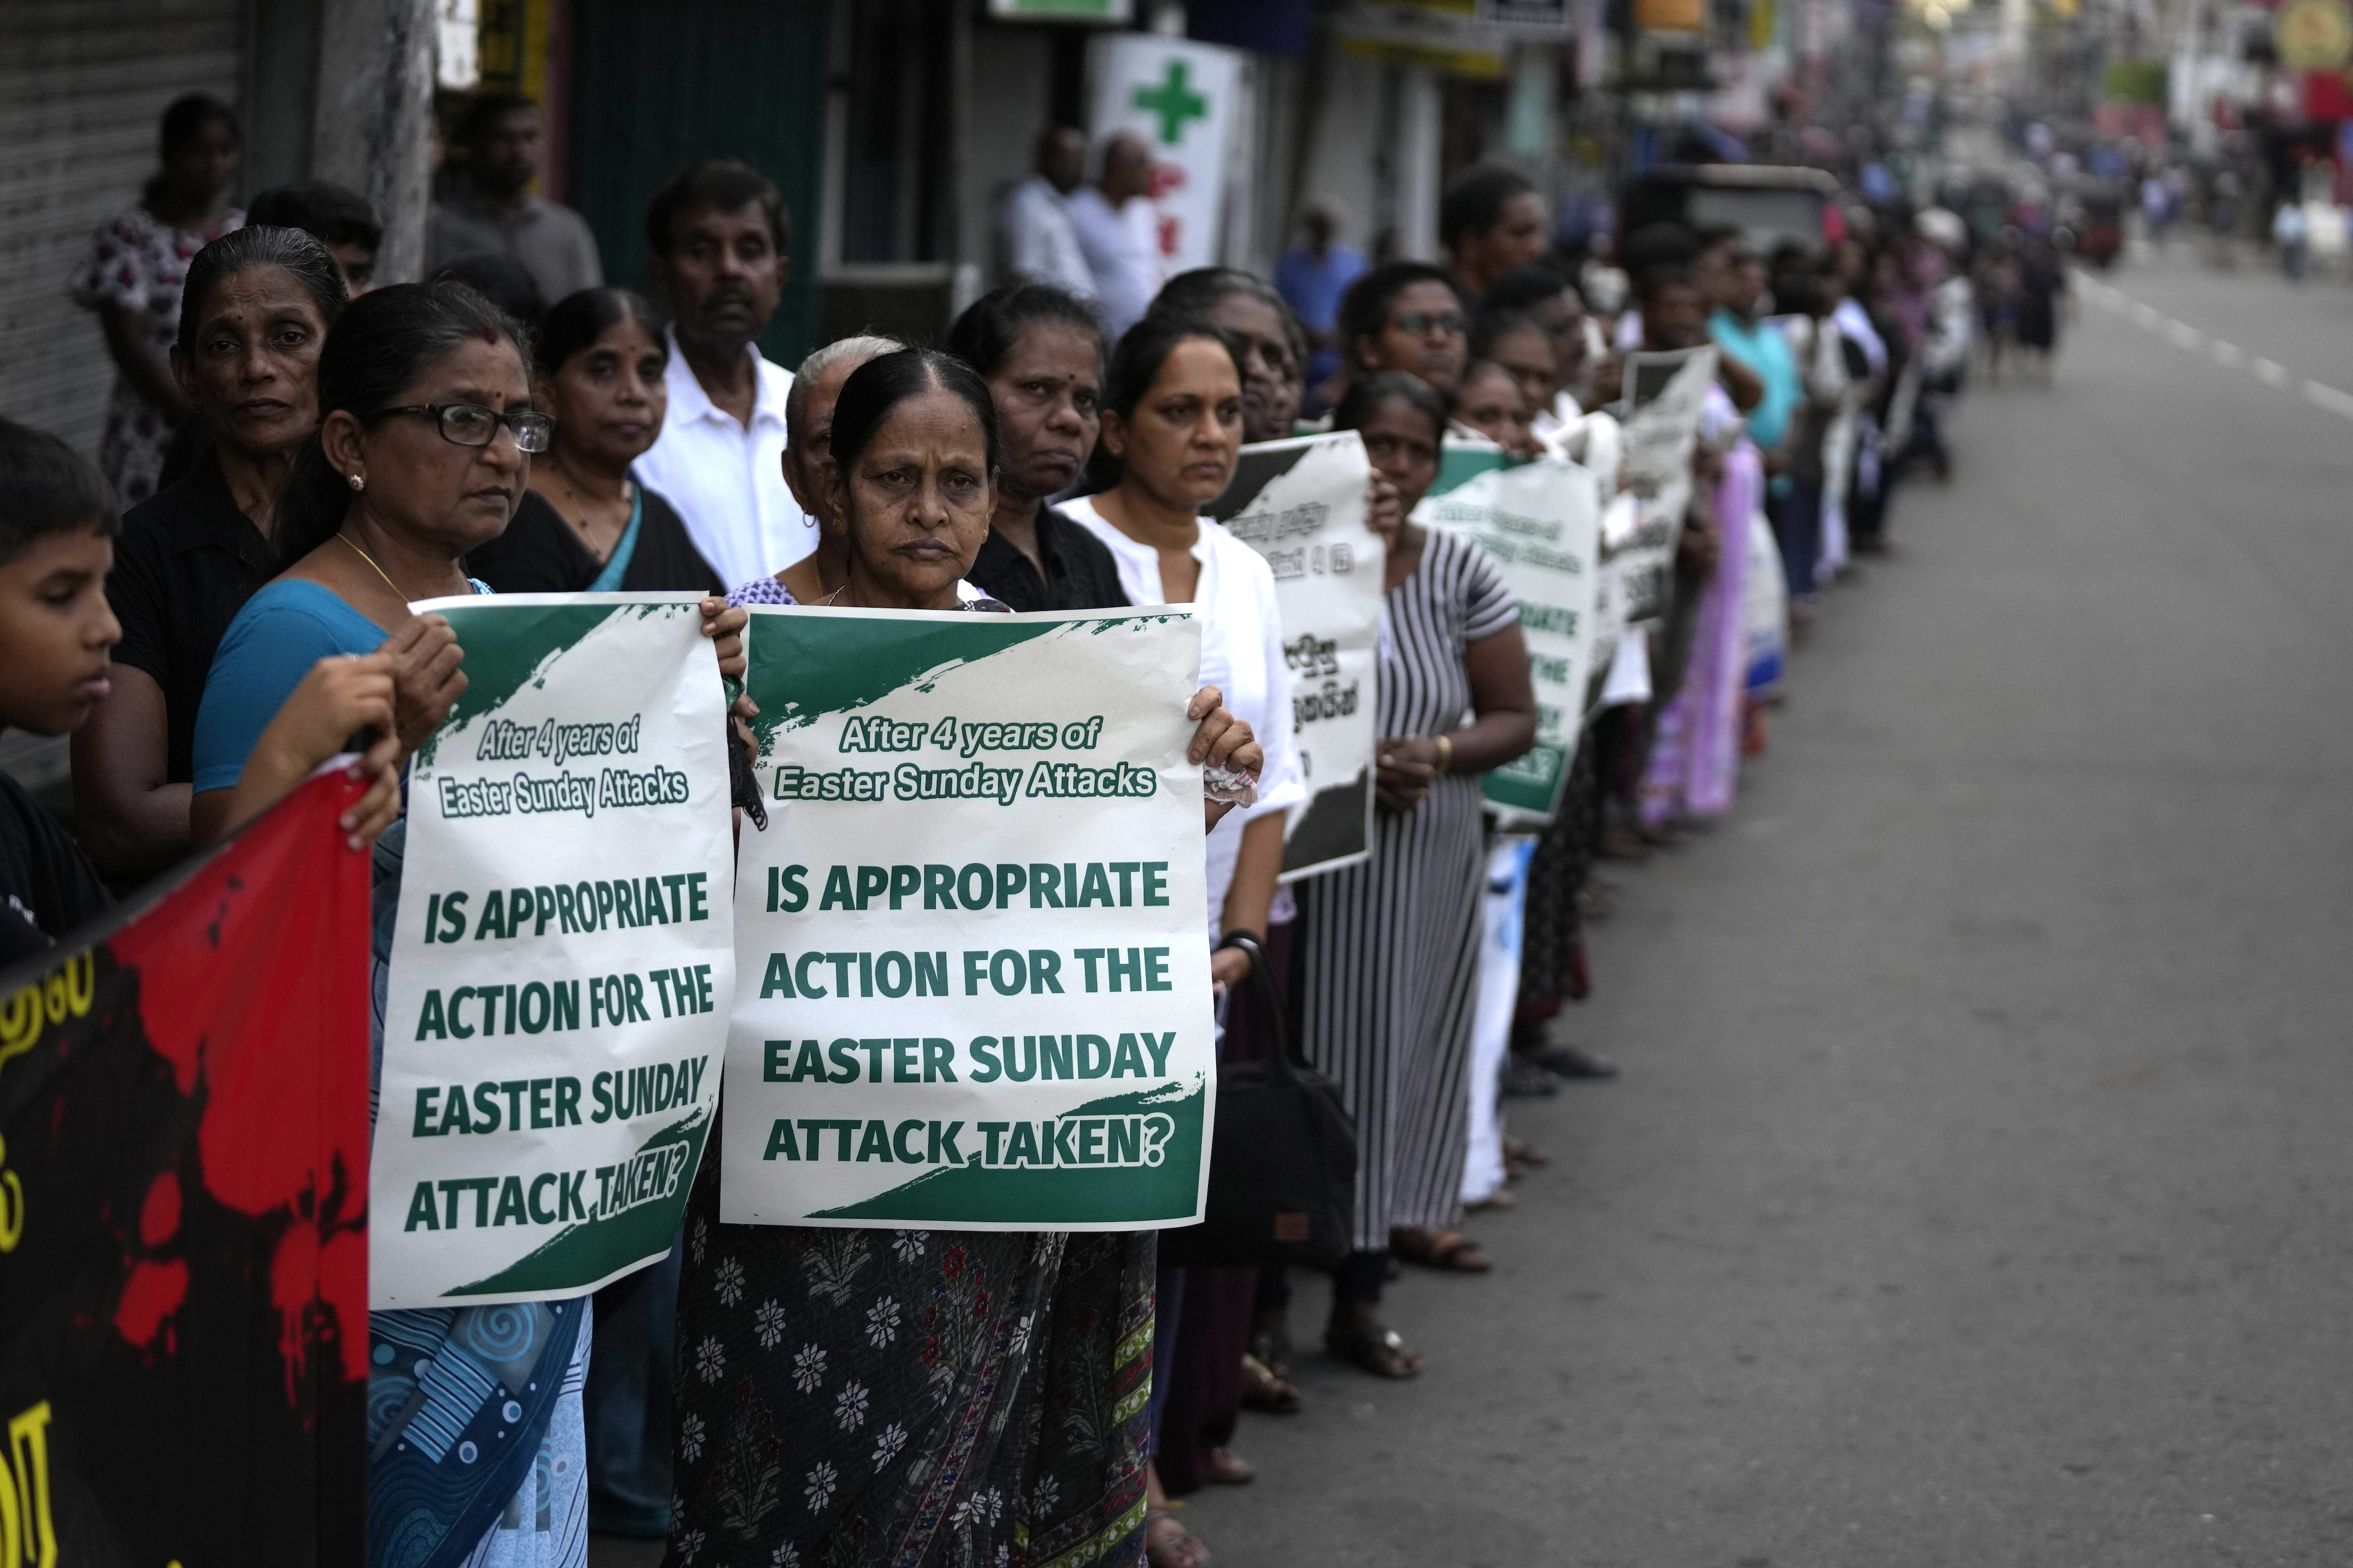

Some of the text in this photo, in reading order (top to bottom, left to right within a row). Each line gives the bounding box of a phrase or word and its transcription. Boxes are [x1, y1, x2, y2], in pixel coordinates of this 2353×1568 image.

[477, 713, 641, 766] After 4 years of
[839, 714, 1103, 758] After 4 years of
[438, 765, 690, 818] Easter Sunday Attacks
[774, 760, 1157, 806] Easter Sunday Attacks
[424, 871, 709, 944] IS APPROPRIATE
[766, 861, 1170, 913] IS APPROPRIATE
[760, 946, 1173, 999] ACTION FOR THE
[414, 963, 715, 1042] ACTION FOR THE
[762, 1031, 1177, 1084] EASTER SUNDAY
[412, 1054, 709, 1138] EASTER SUNDAY
[762, 1112, 1175, 1168] ATTACK TAKEN?
[404, 1141, 690, 1232] ATTACK TAKEN?
